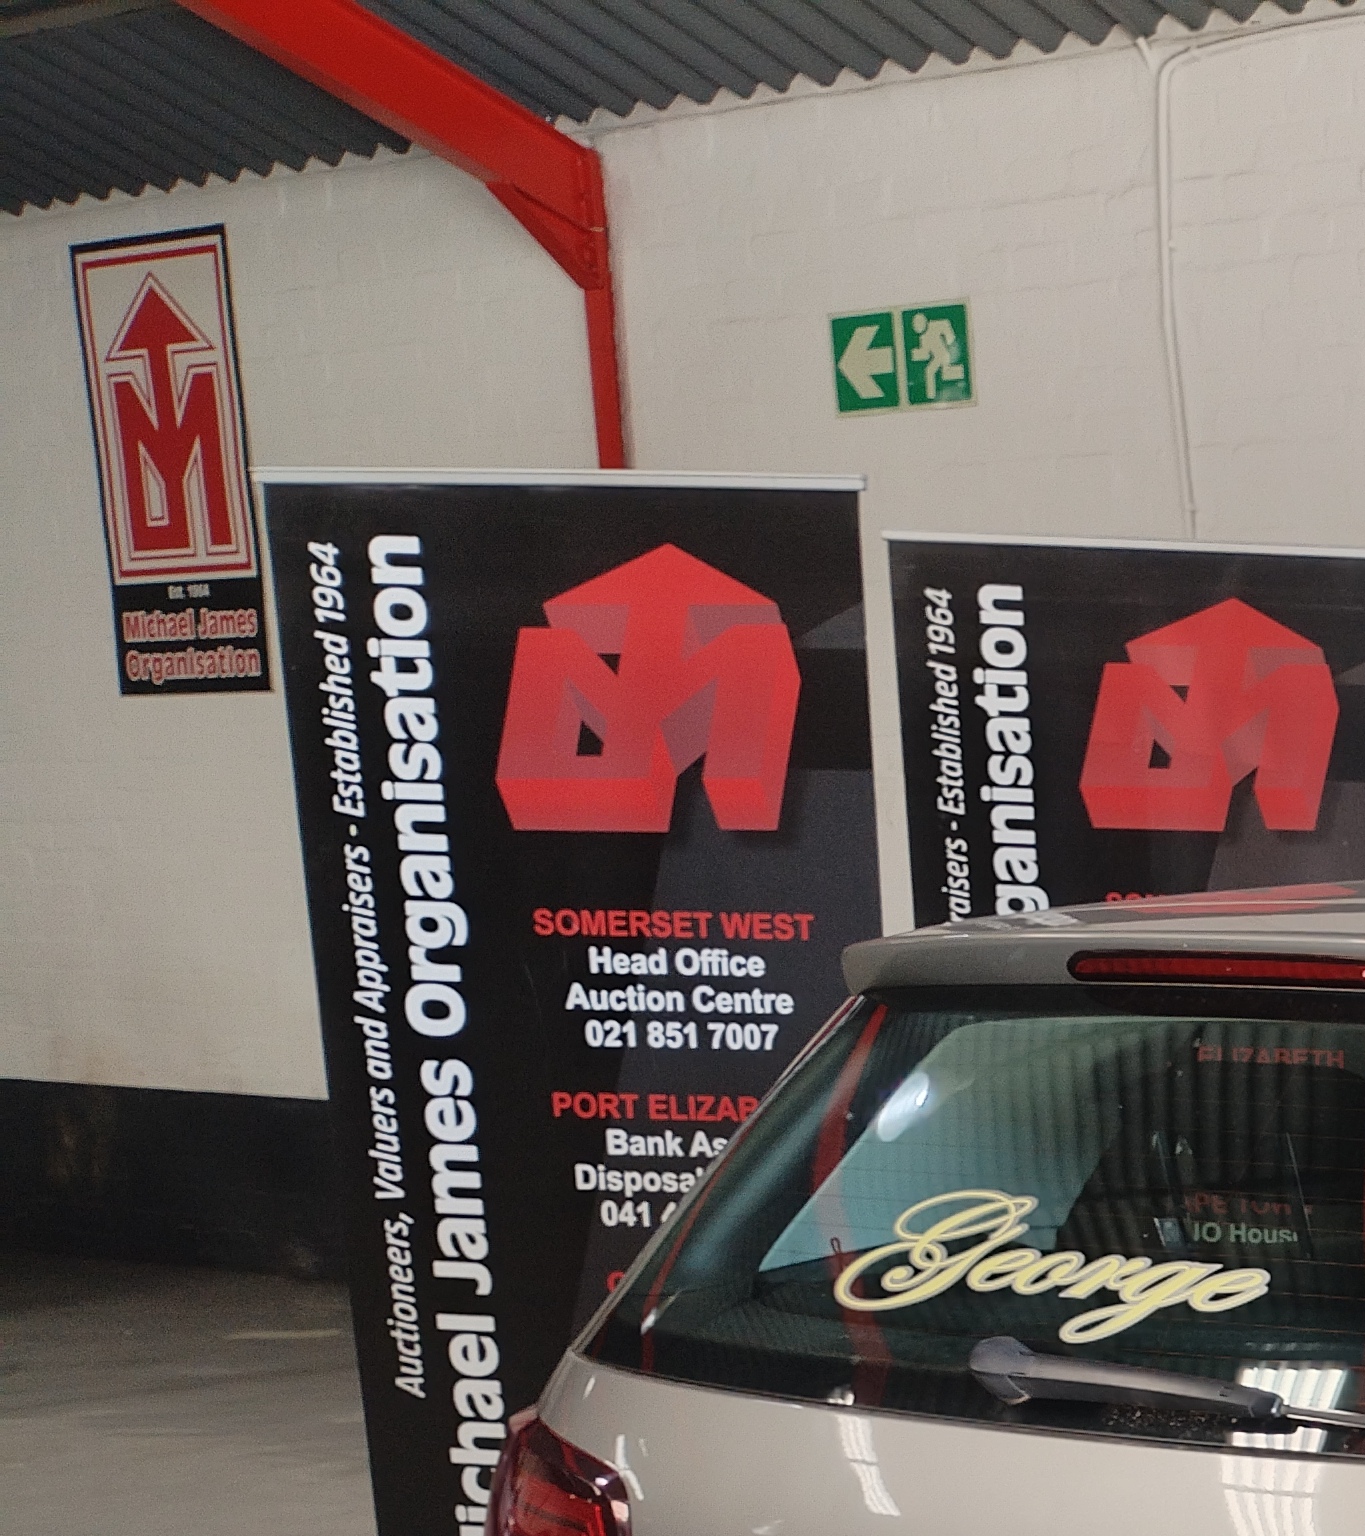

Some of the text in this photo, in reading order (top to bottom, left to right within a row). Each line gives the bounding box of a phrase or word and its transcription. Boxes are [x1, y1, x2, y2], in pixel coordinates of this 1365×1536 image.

[307, 541, 346, 623] 1964
[122, 607, 258, 643] Michael James
[923, 587, 956, 655] 1964
[125, 645, 262, 686] Organisation
[314, 630, 365, 818] Established
[927, 660, 966, 815] Established
[973, 583, 1049, 916] ganisation
[366, 535, 468, 1037] Organisation
[342, 843, 390, 1014] Appraisers
[532, 907, 815, 941] SOMERSET WEST
[588, 945, 766, 977] Head Office
[565, 981, 795, 1015] Auction Centre
[353, 1015, 393, 1080] and
[584, 1019, 779, 1051] 021 851 7007
[551, 1091, 639, 1120] PORT
[368, 1086, 405, 1199] Valuers
[605, 1127, 685, 1157] Bank
[420, 1059, 492, 1297] James
[600, 1200, 652, 1227] 041
[833, 1188, 1271, 1344] George
[385, 1212, 425, 1398] Auctioneers,
